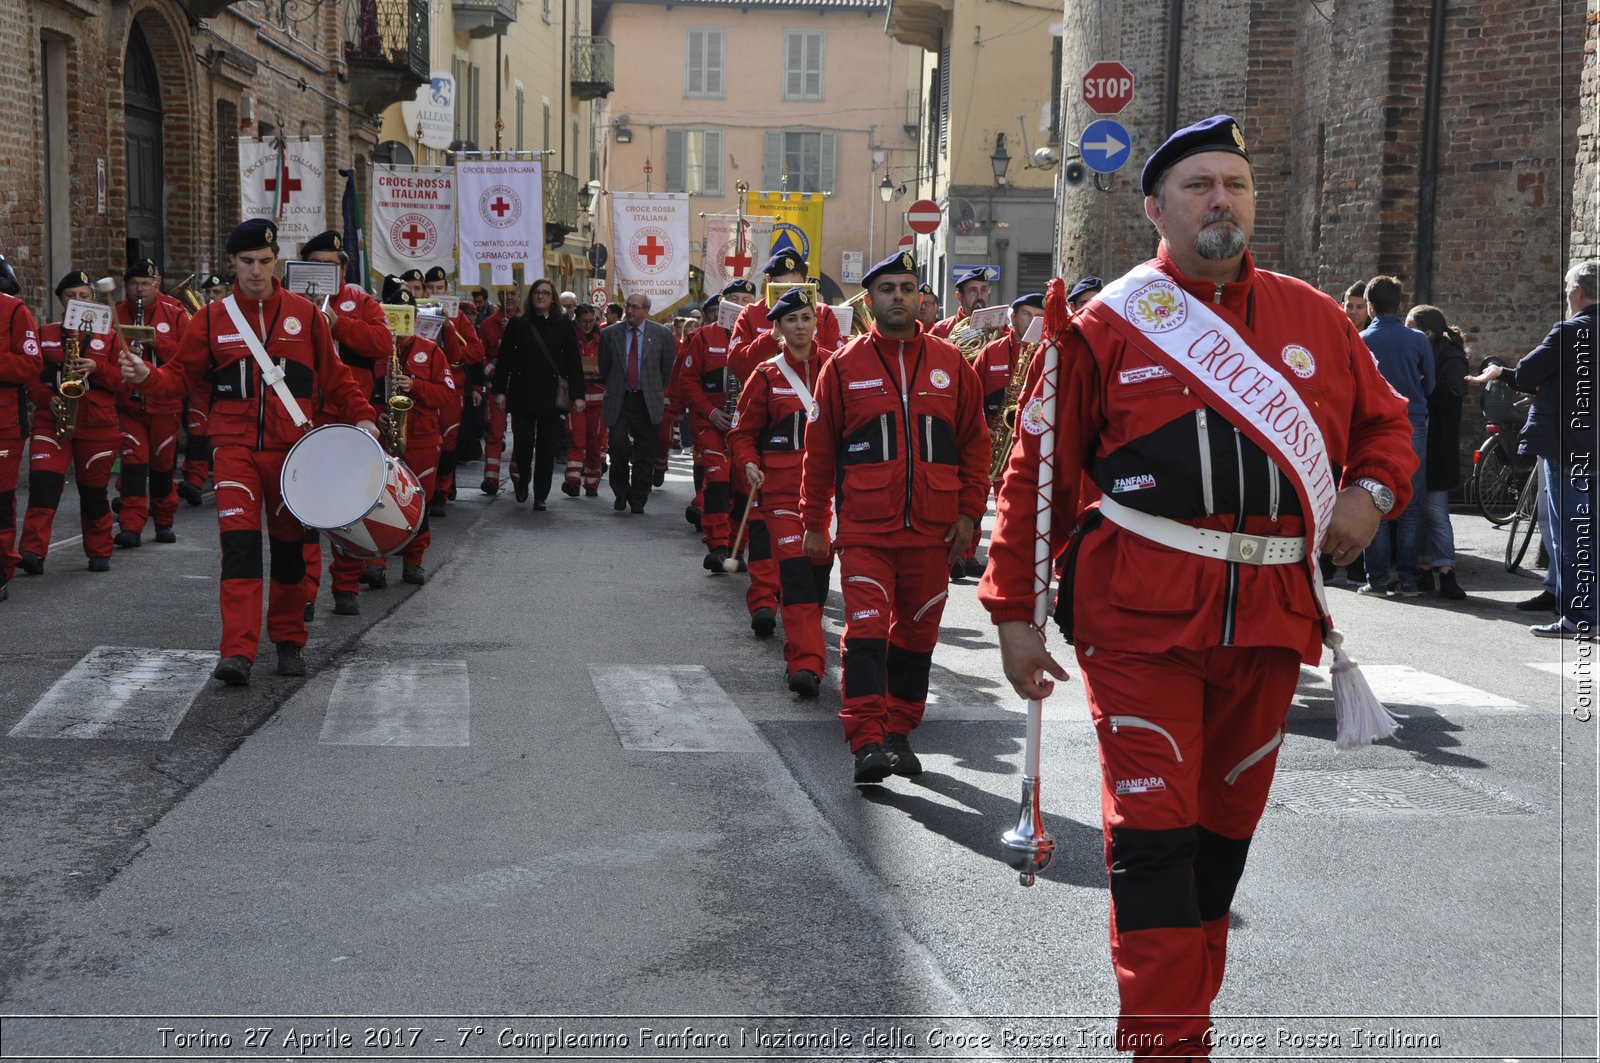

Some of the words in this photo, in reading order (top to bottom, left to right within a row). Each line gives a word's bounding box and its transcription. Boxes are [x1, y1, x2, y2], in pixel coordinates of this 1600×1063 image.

[1084, 77, 1131, 98] STOP
[463, 166, 485, 174] CROCE
[379, 176, 415, 187] CROCE
[417, 179, 452, 189] ROSSA
[391, 189, 438, 200] ITALIANA
[290, 206, 321, 214] LOCALE
[378, 201, 400, 209] COMITATO
[401, 202, 429, 210] PROVINCIALE
[625, 205, 650, 213] CROCE
[652, 205, 676, 213] ROSSA
[633, 214, 668, 222] ITALIANA
[473, 240, 505, 248] COMITATO
[475, 251, 528, 260] CARMAGNOLA
[621, 279, 655, 287] COMITATO
[656, 279, 684, 287] LOCALE
[1148, 281, 1176, 292] ITALIANA
[1129, 289, 1149, 305] ROSSA
[1127, 304, 1141, 325] CROCE
[1153, 301, 1185, 331] FANFARA
[1122, 368, 1154, 379] Domenico
[1127, 373, 1147, 382] DRUM
[1187, 329, 1273, 405] CROCE
[1256, 388, 1322, 477] ROSSA
[1114, 473, 1155, 488] FANFARA
[1121, 776, 1165, 789] FANFARA
